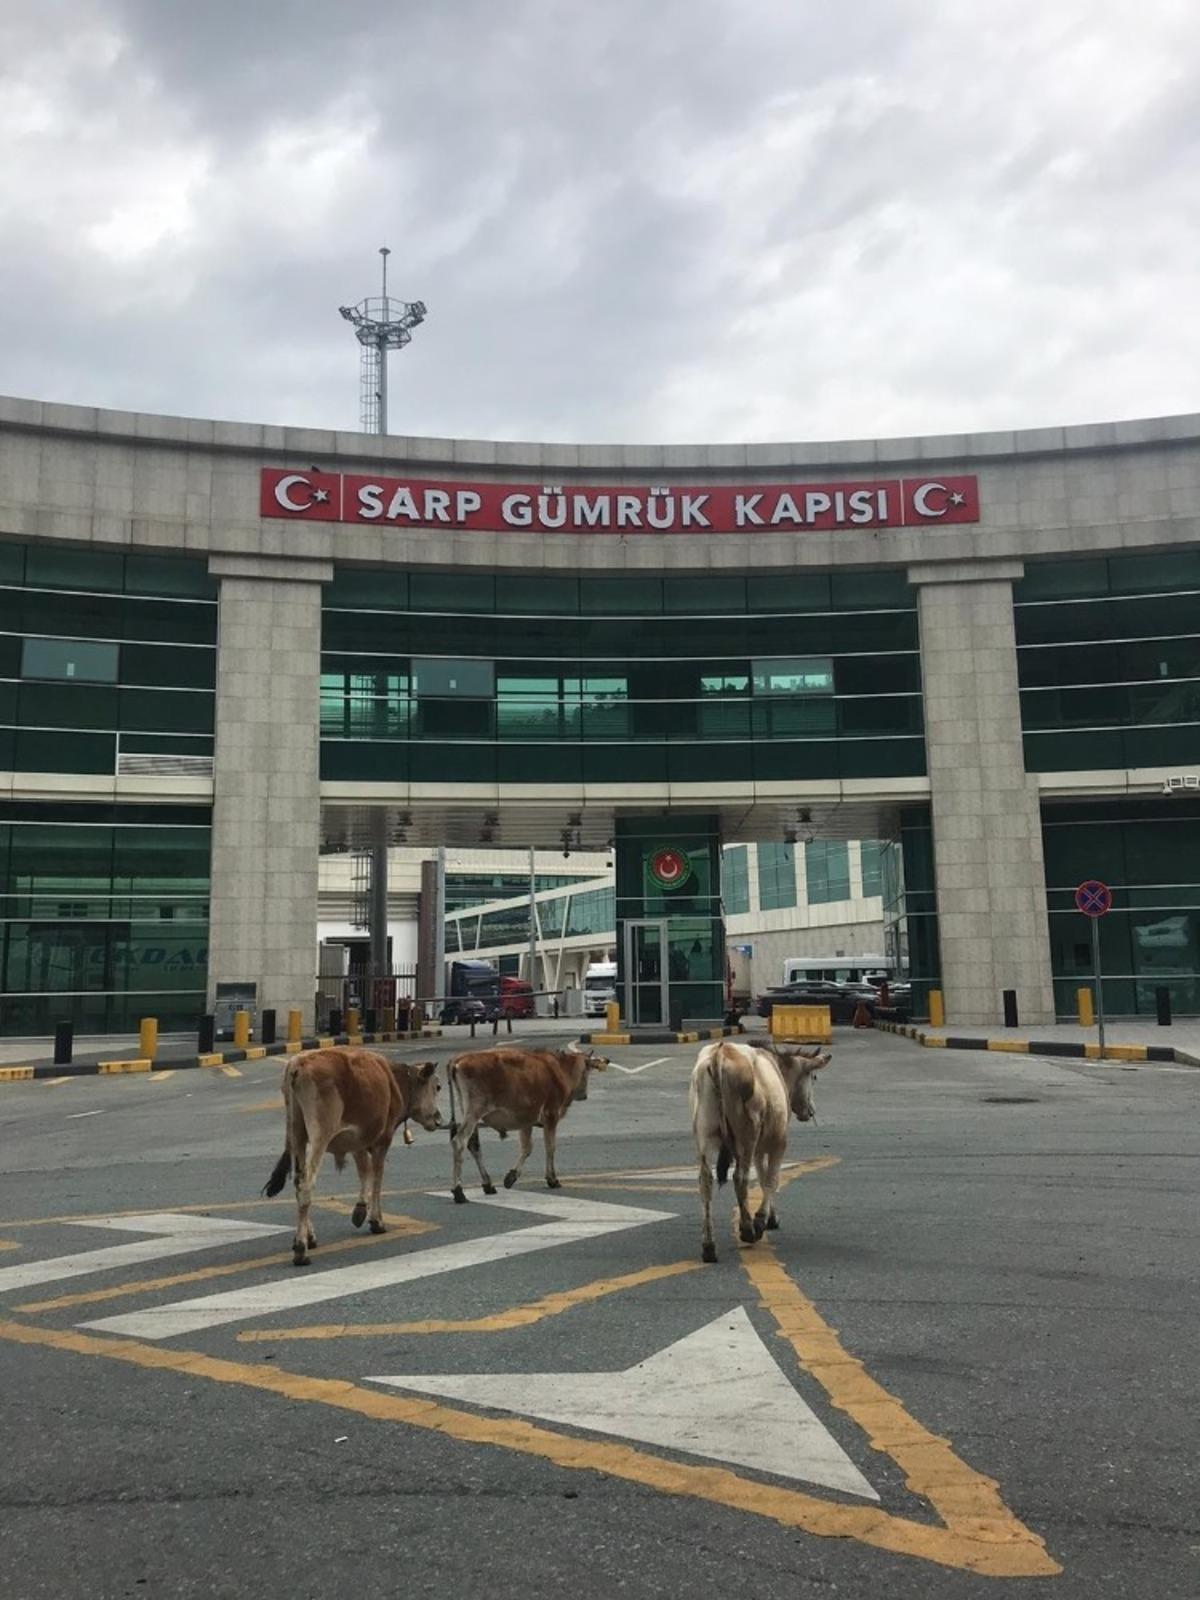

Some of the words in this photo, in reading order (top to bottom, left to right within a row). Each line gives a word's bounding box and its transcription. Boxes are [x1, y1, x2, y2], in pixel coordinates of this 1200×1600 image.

[357, 484, 482, 523] SARP
[501, 485, 711, 530] GÜMRÜK
[735, 488, 889, 527] KAPISI
